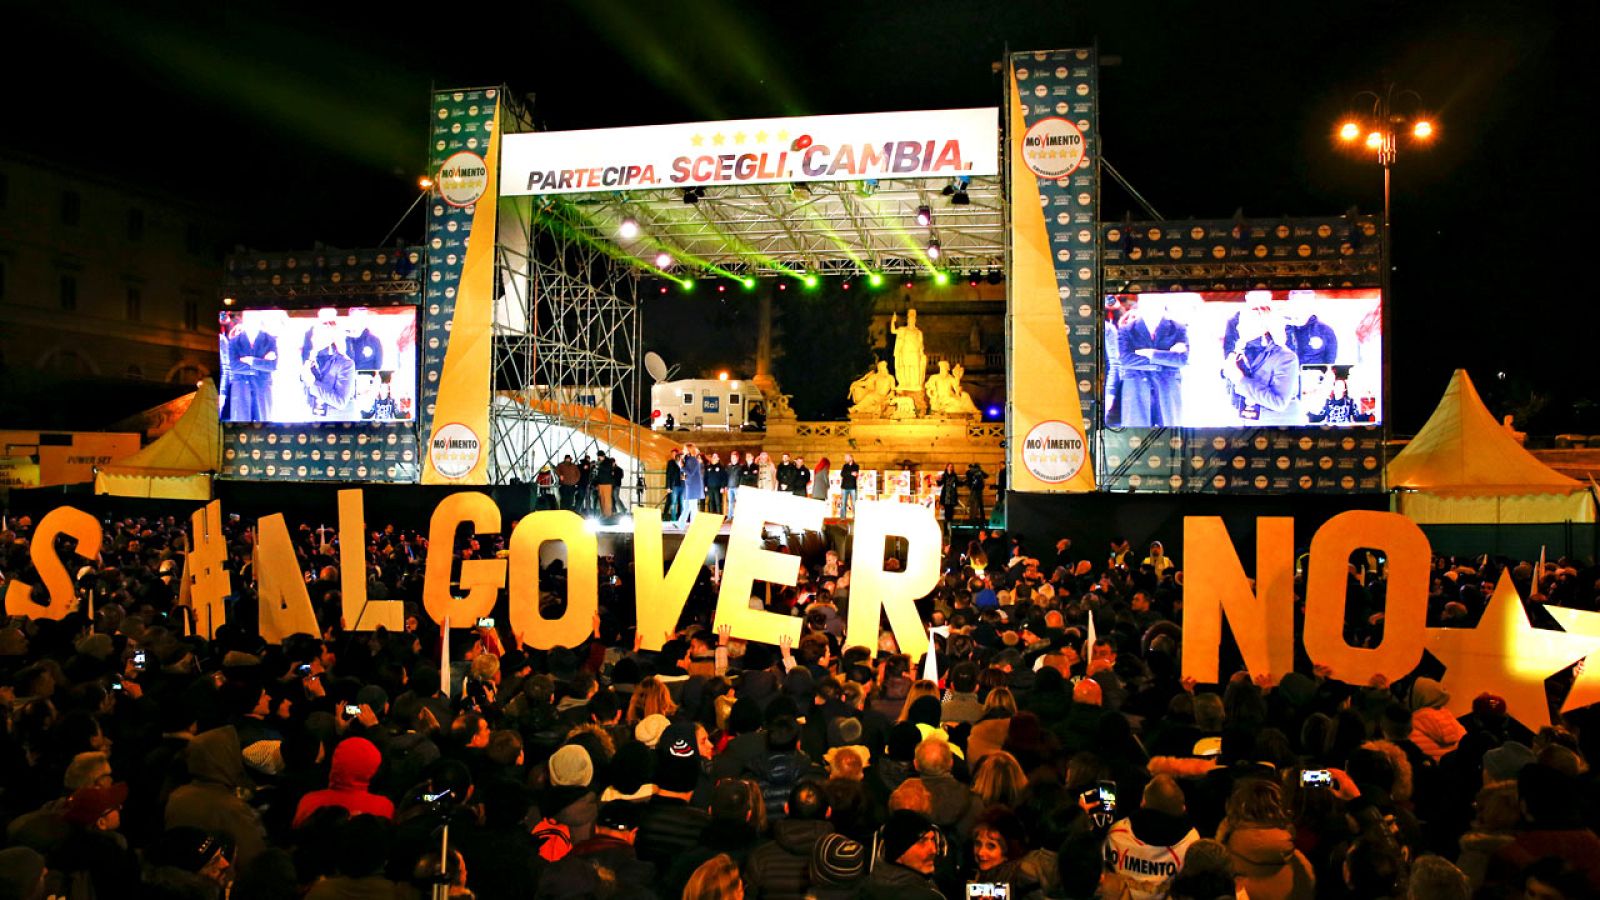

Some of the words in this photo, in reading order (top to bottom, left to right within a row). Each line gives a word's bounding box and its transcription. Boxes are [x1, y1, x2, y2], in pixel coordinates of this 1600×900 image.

[1025, 132, 1080, 148] MOVIMENTO
[669, 151, 793, 184] SCEGLI.
[801, 138, 973, 178] CAMBIA.
[441, 166, 485, 179] MOVIMENTO
[433, 436, 478, 450] MOVIMENTO
[1027, 436, 1081, 450] MOVIMENTO
